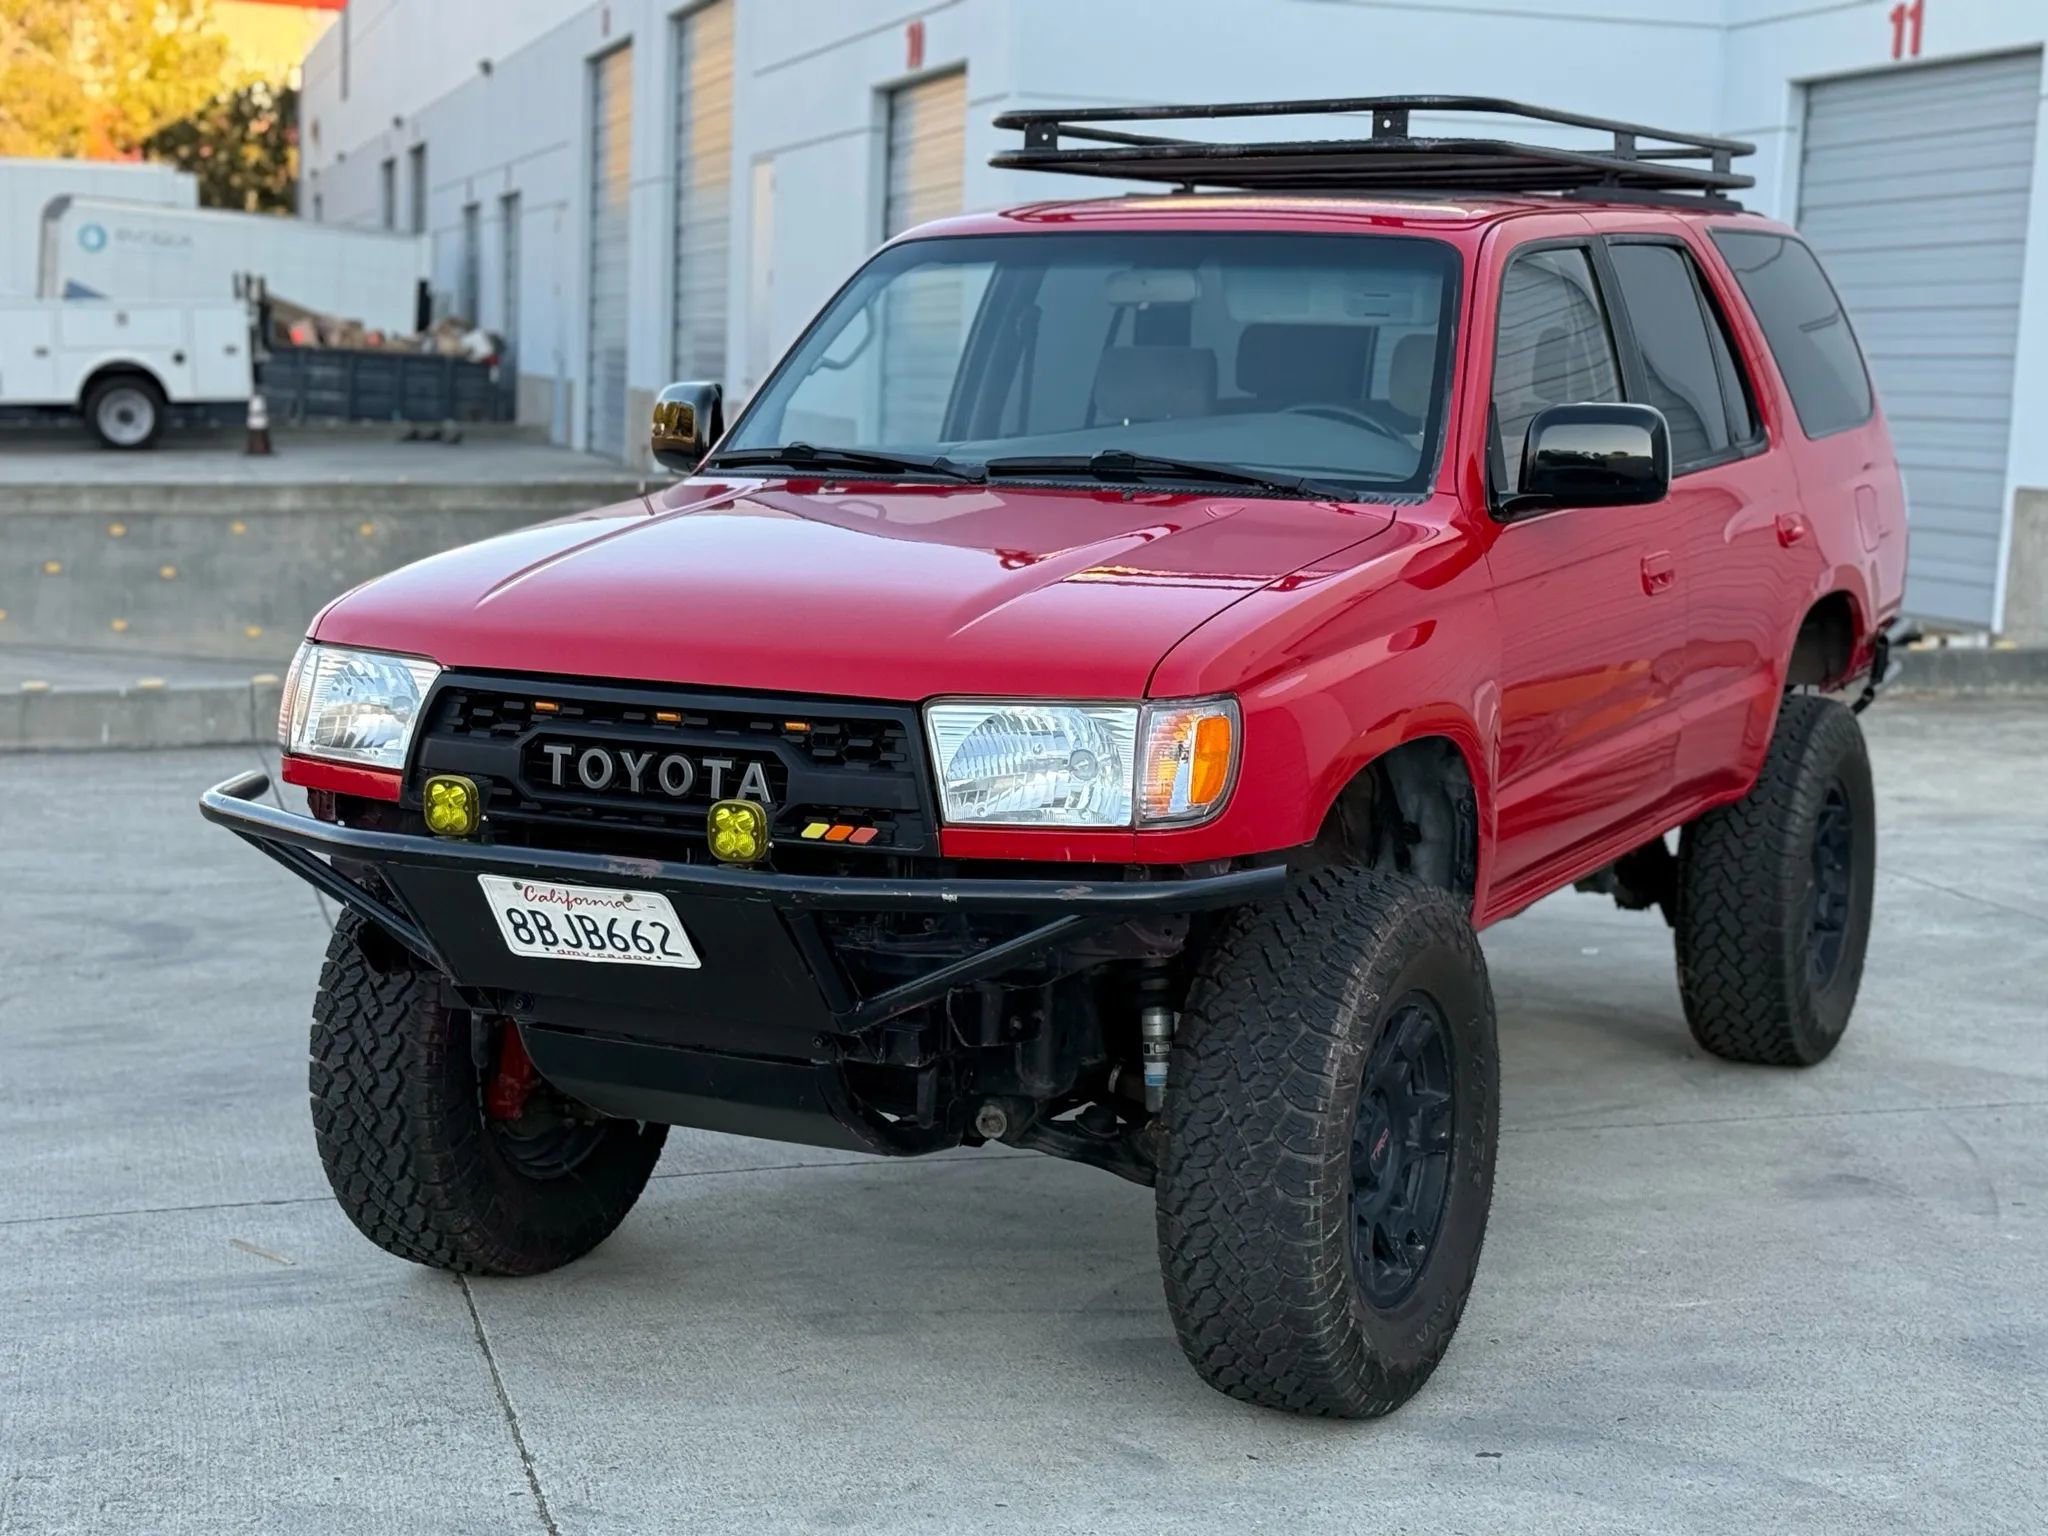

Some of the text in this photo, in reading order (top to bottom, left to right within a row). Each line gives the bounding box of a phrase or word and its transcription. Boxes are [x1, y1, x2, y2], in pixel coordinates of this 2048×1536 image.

[1890, 0, 1924, 59] 11
[543, 744, 771, 803] TOYOTA
[523, 884, 641, 911] California
[506, 907, 683, 957] 8BJB662
[556, 948, 652, 961] dmv.ca.gov
